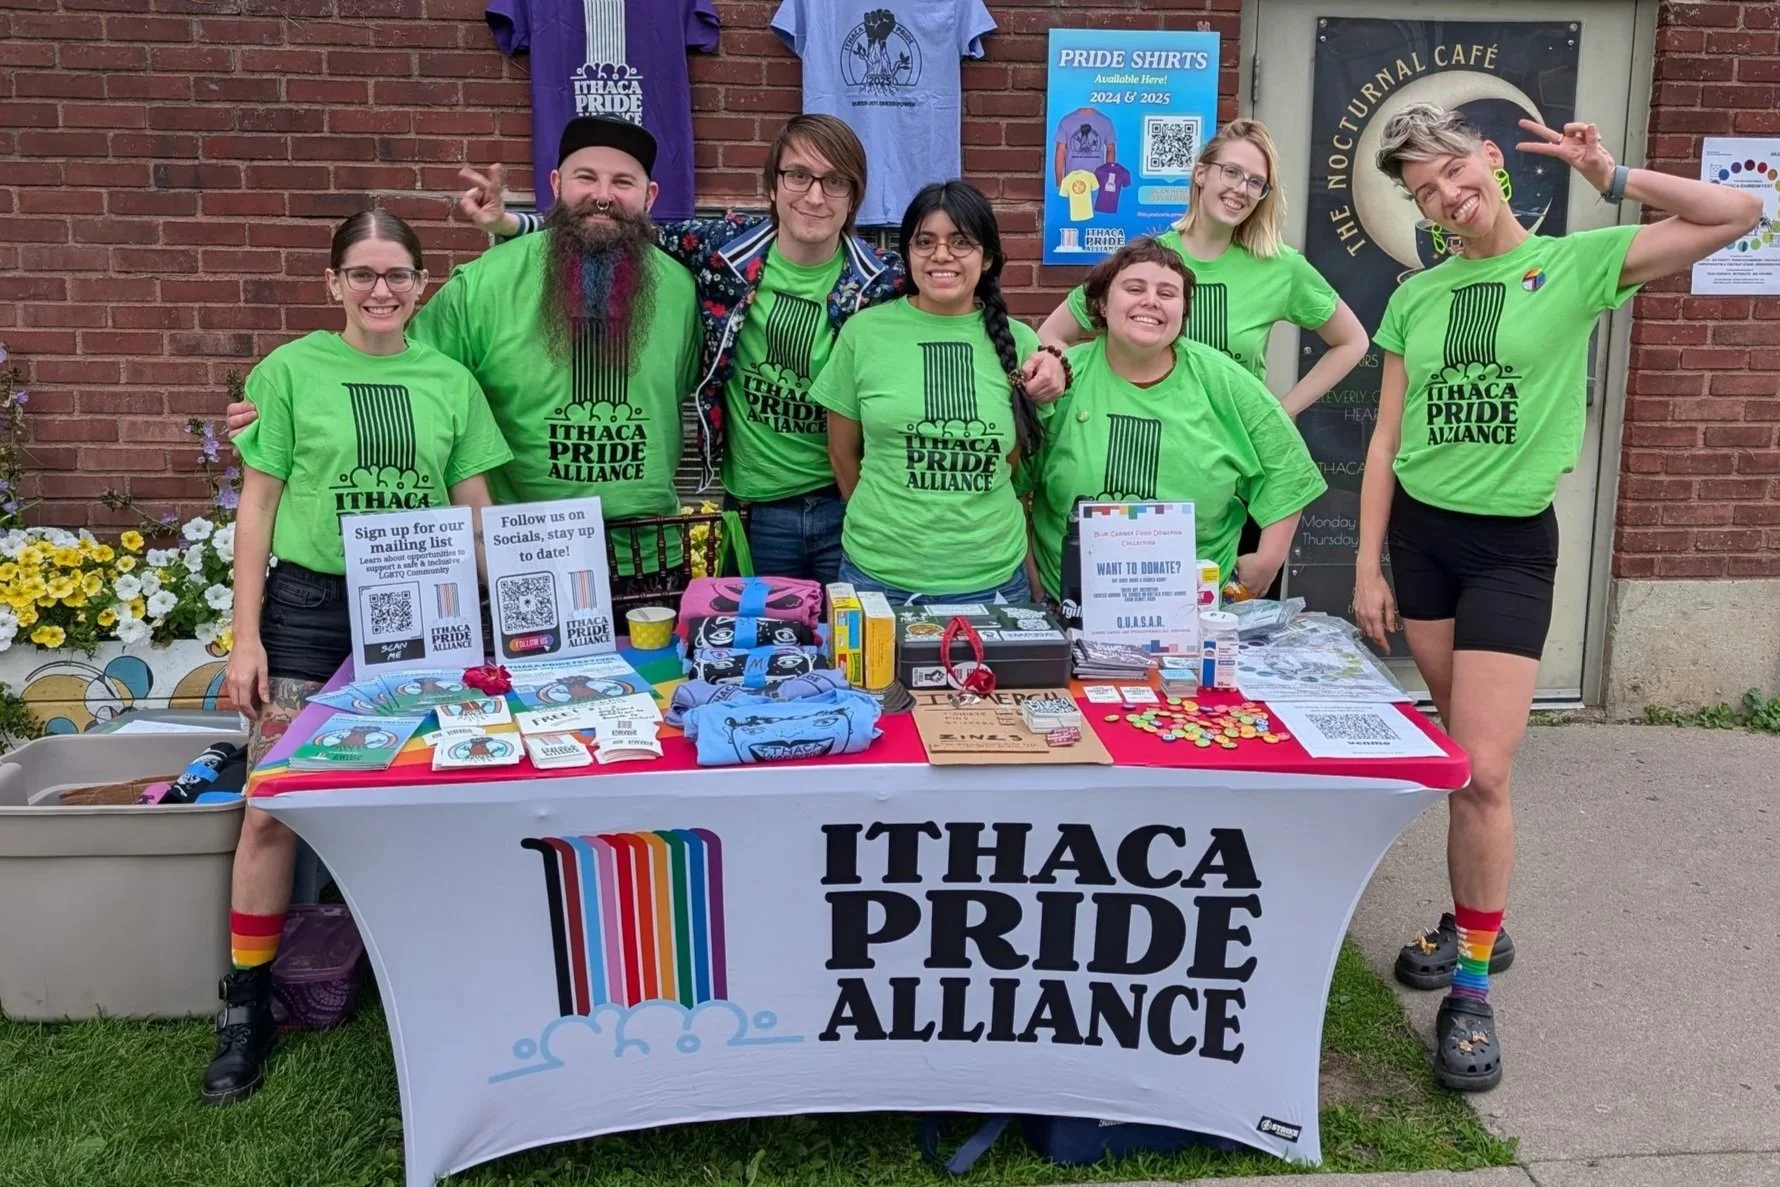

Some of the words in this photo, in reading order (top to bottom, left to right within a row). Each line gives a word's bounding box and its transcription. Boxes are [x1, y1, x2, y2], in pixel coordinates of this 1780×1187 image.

[845, 26, 864, 52] ITHACA
[895, 26, 915, 46] PRIDE
[1059, 49, 1125, 68] PRIDE
[1132, 51, 1209, 70] SHIRTS
[1434, 43, 1499, 69] CAFÉ
[574, 80, 643, 94] ITHACA
[868, 76, 892, 86] 2025
[1094, 74, 1139, 84] Available
[1141, 74, 1168, 85] Here!
[575, 94, 643, 113] PRIDE
[1090, 91, 1121, 104] 2024
[1124, 92, 1138, 104] &
[1140, 92, 1171, 105] 2025
[1328, 52, 1427, 190] NOCTURNAL
[1086, 229, 1125, 237] ITHACA
[1330, 204, 1366, 257] THE
[1086, 237, 1125, 246] PRIDE
[1427, 382, 1519, 401] ITHACA
[744, 389, 828, 421] PRIDE
[1427, 401, 1519, 425] PRIDE
[549, 424, 647, 441] ITHACA
[548, 440, 647, 464] PRIDE
[904, 435, 1001, 453] ITHACA
[905, 449, 1000, 474] PRIDE
[1318, 462, 1366, 475] THACA
[547, 462, 645, 483] ALLIANCE
[905, 471, 994, 492] ALLIANCE
[335, 491, 430, 510] ITHACA
[501, 513, 546, 528] Follow
[550, 513, 565, 522] us
[568, 510, 585, 520] on
[1302, 515, 1356, 534] Monday
[355, 526, 386, 541] Sign
[391, 526, 409, 539] up
[413, 522, 435, 535] for
[439, 521, 464, 532] our
[493, 530, 545, 546] Socials,
[547, 527, 575, 540] stay
[577, 526, 595, 539] up
[370, 538, 427, 554] mailing
[430, 536, 453, 549] list
[1302, 533, 1359, 549] Thursday
[359, 556, 382, 565] Learn
[383, 554, 406, 562] about
[407, 549, 456, 563] opportunities
[519, 550, 533, 562] to
[536, 546, 570, 560] date!
[366, 563, 395, 573] support
[403, 560, 418, 568] safe
[427, 557, 460, 567] inclusive
[378, 570, 406, 580] LGBTQ
[406, 566, 450, 577] Community
[1096, 562, 1122, 576] WANT
[1126, 562, 1138, 575] TO
[1141, 560, 1182, 575] DONATE?
[431, 624, 471, 635] ITHACA
[566, 616, 608, 629] ITHACA
[1116, 615, 1165, 629] Q.U.A.S.A.R.
[432, 631, 472, 644] PRIDE
[567, 624, 610, 639] PRIDE
[380, 642, 408, 653] SCAN
[432, 640, 472, 652] ALLIANCE
[515, 637, 539, 649] FOLLOW
[568, 634, 611, 648] ALLIANCE
[387, 650, 401, 660] ME
[939, 733, 1023, 742] ZINES
[820, 820, 1262, 889] ITHACA
[825, 889, 1263, 982] PRIDE
[818, 977, 1246, 1065] ALLIANCE
[1271, 1123, 1299, 1138] STRIKE
